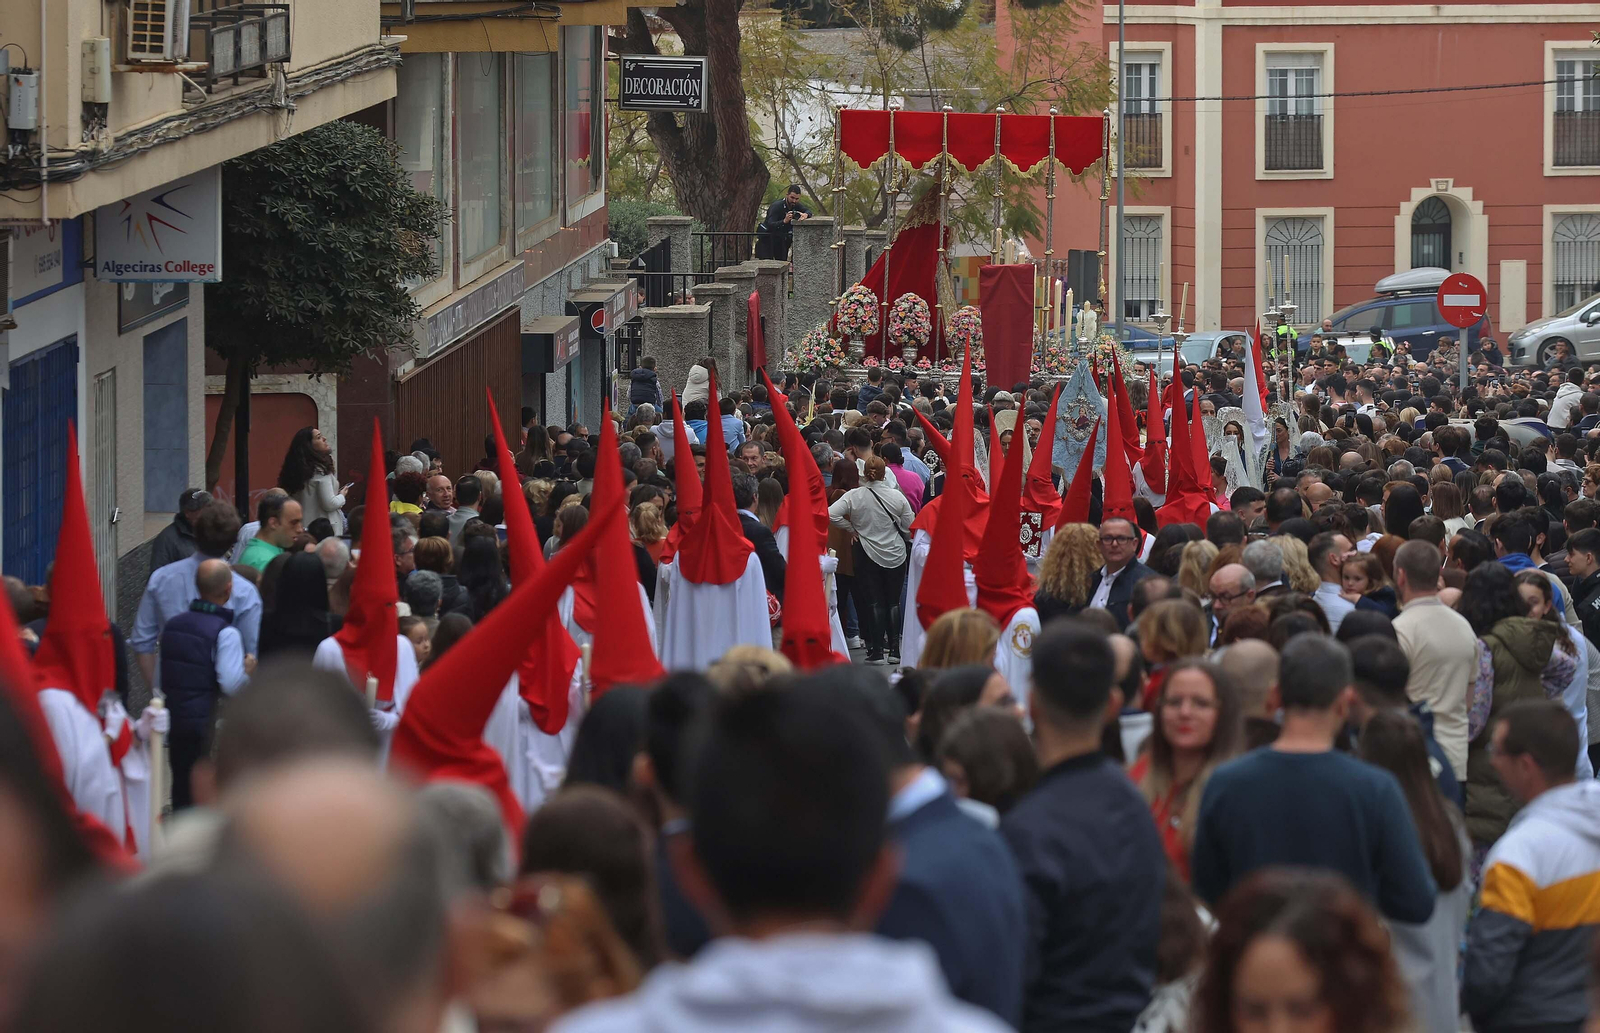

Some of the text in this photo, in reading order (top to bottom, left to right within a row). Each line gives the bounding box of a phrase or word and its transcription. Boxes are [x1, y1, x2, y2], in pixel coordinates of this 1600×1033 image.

[624, 74, 701, 96] DECORACIÓN
[101, 260, 215, 276] Algeciras College
